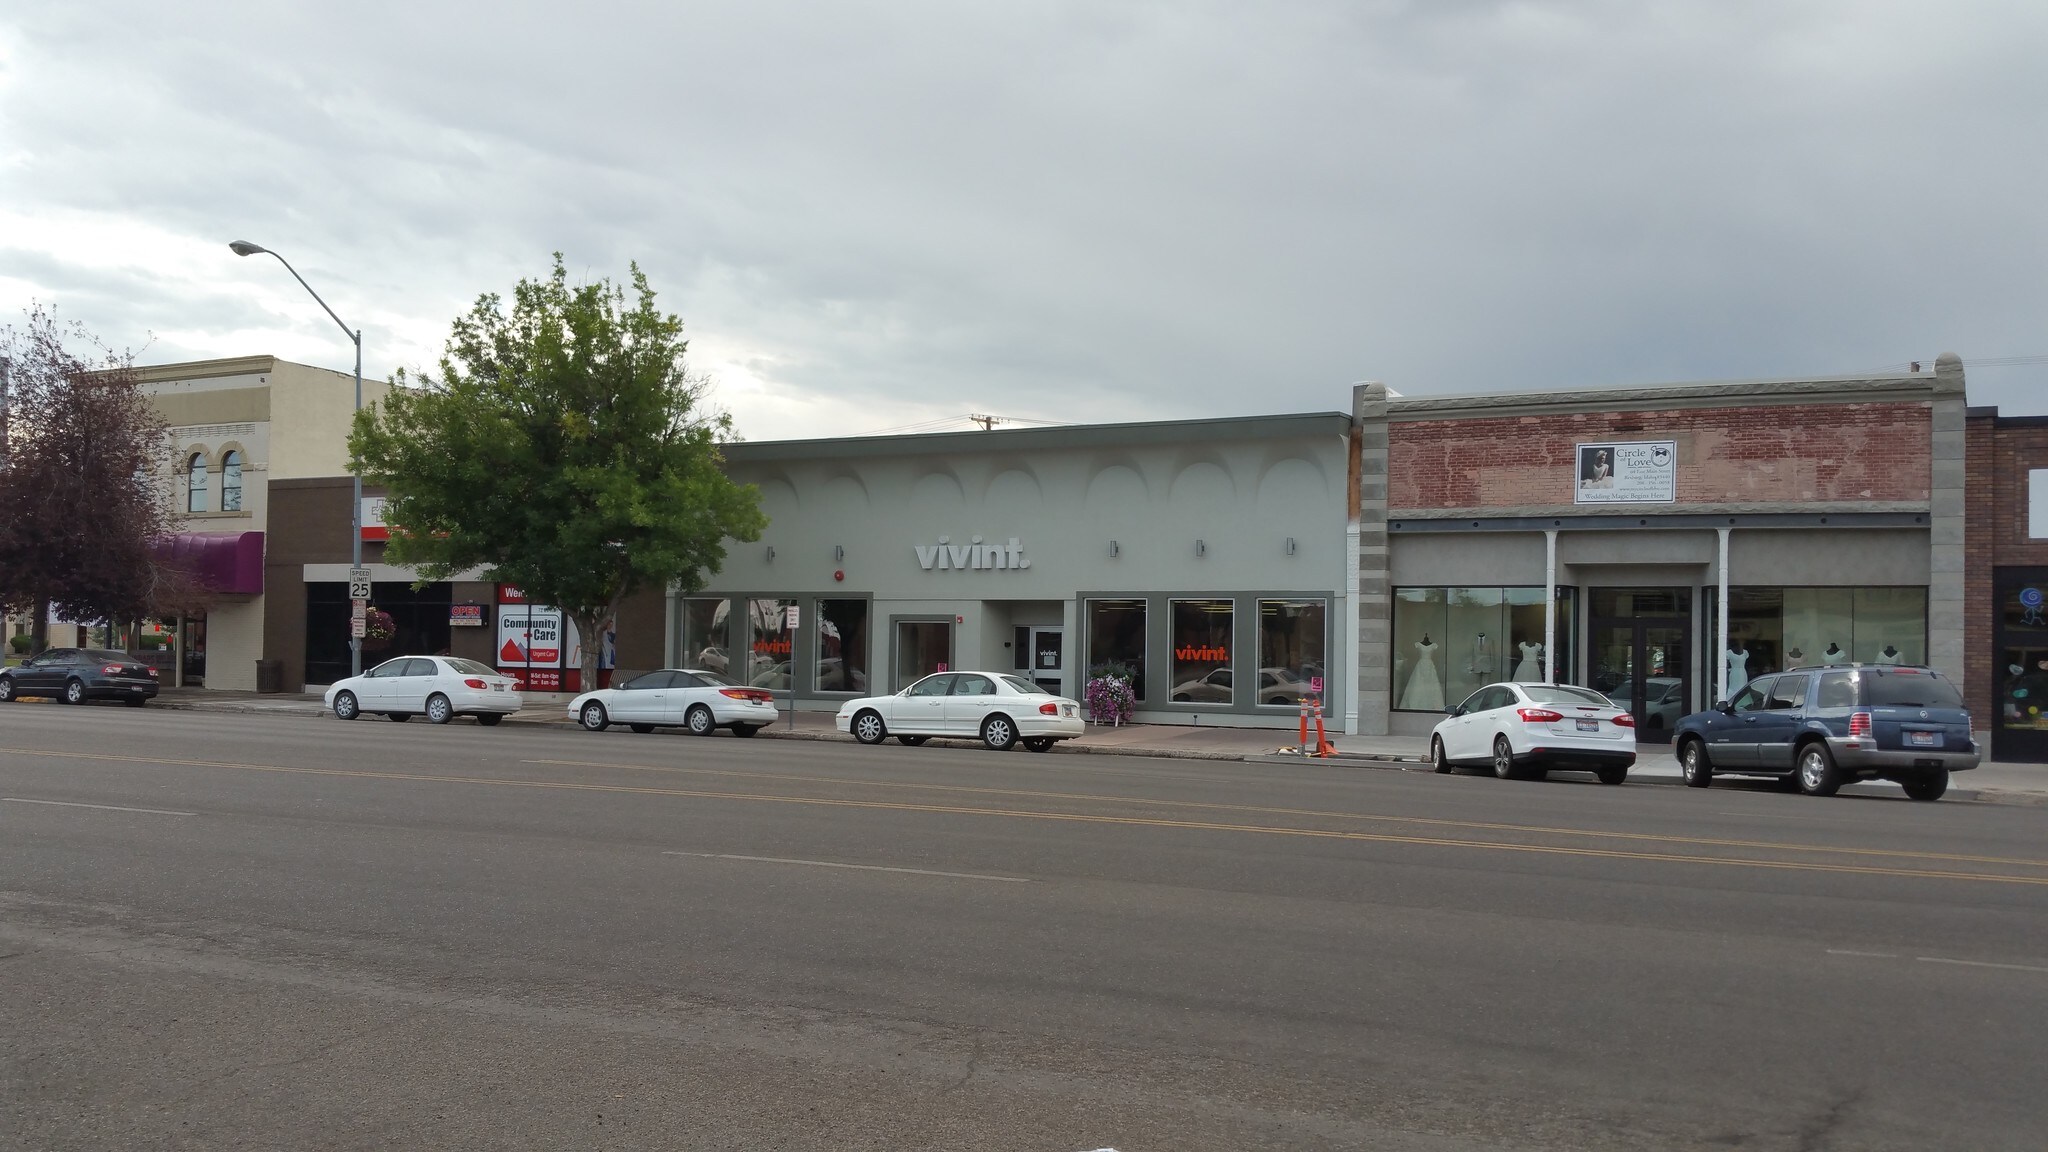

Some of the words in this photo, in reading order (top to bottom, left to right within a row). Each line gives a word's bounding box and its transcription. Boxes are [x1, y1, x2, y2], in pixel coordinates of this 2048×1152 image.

[1616, 448, 1646, 458] Circle
[1627, 459, 1652, 467] Love
[915, 535, 1031, 570] vivint.
[352, 583, 369, 597] 25
[451, 605, 480, 616] OPEN
[504, 619, 557, 630] Community
[534, 629, 556, 641] Care
[532, 651, 545, 659] Urgent
[1176, 645, 1229, 661] vivint.
